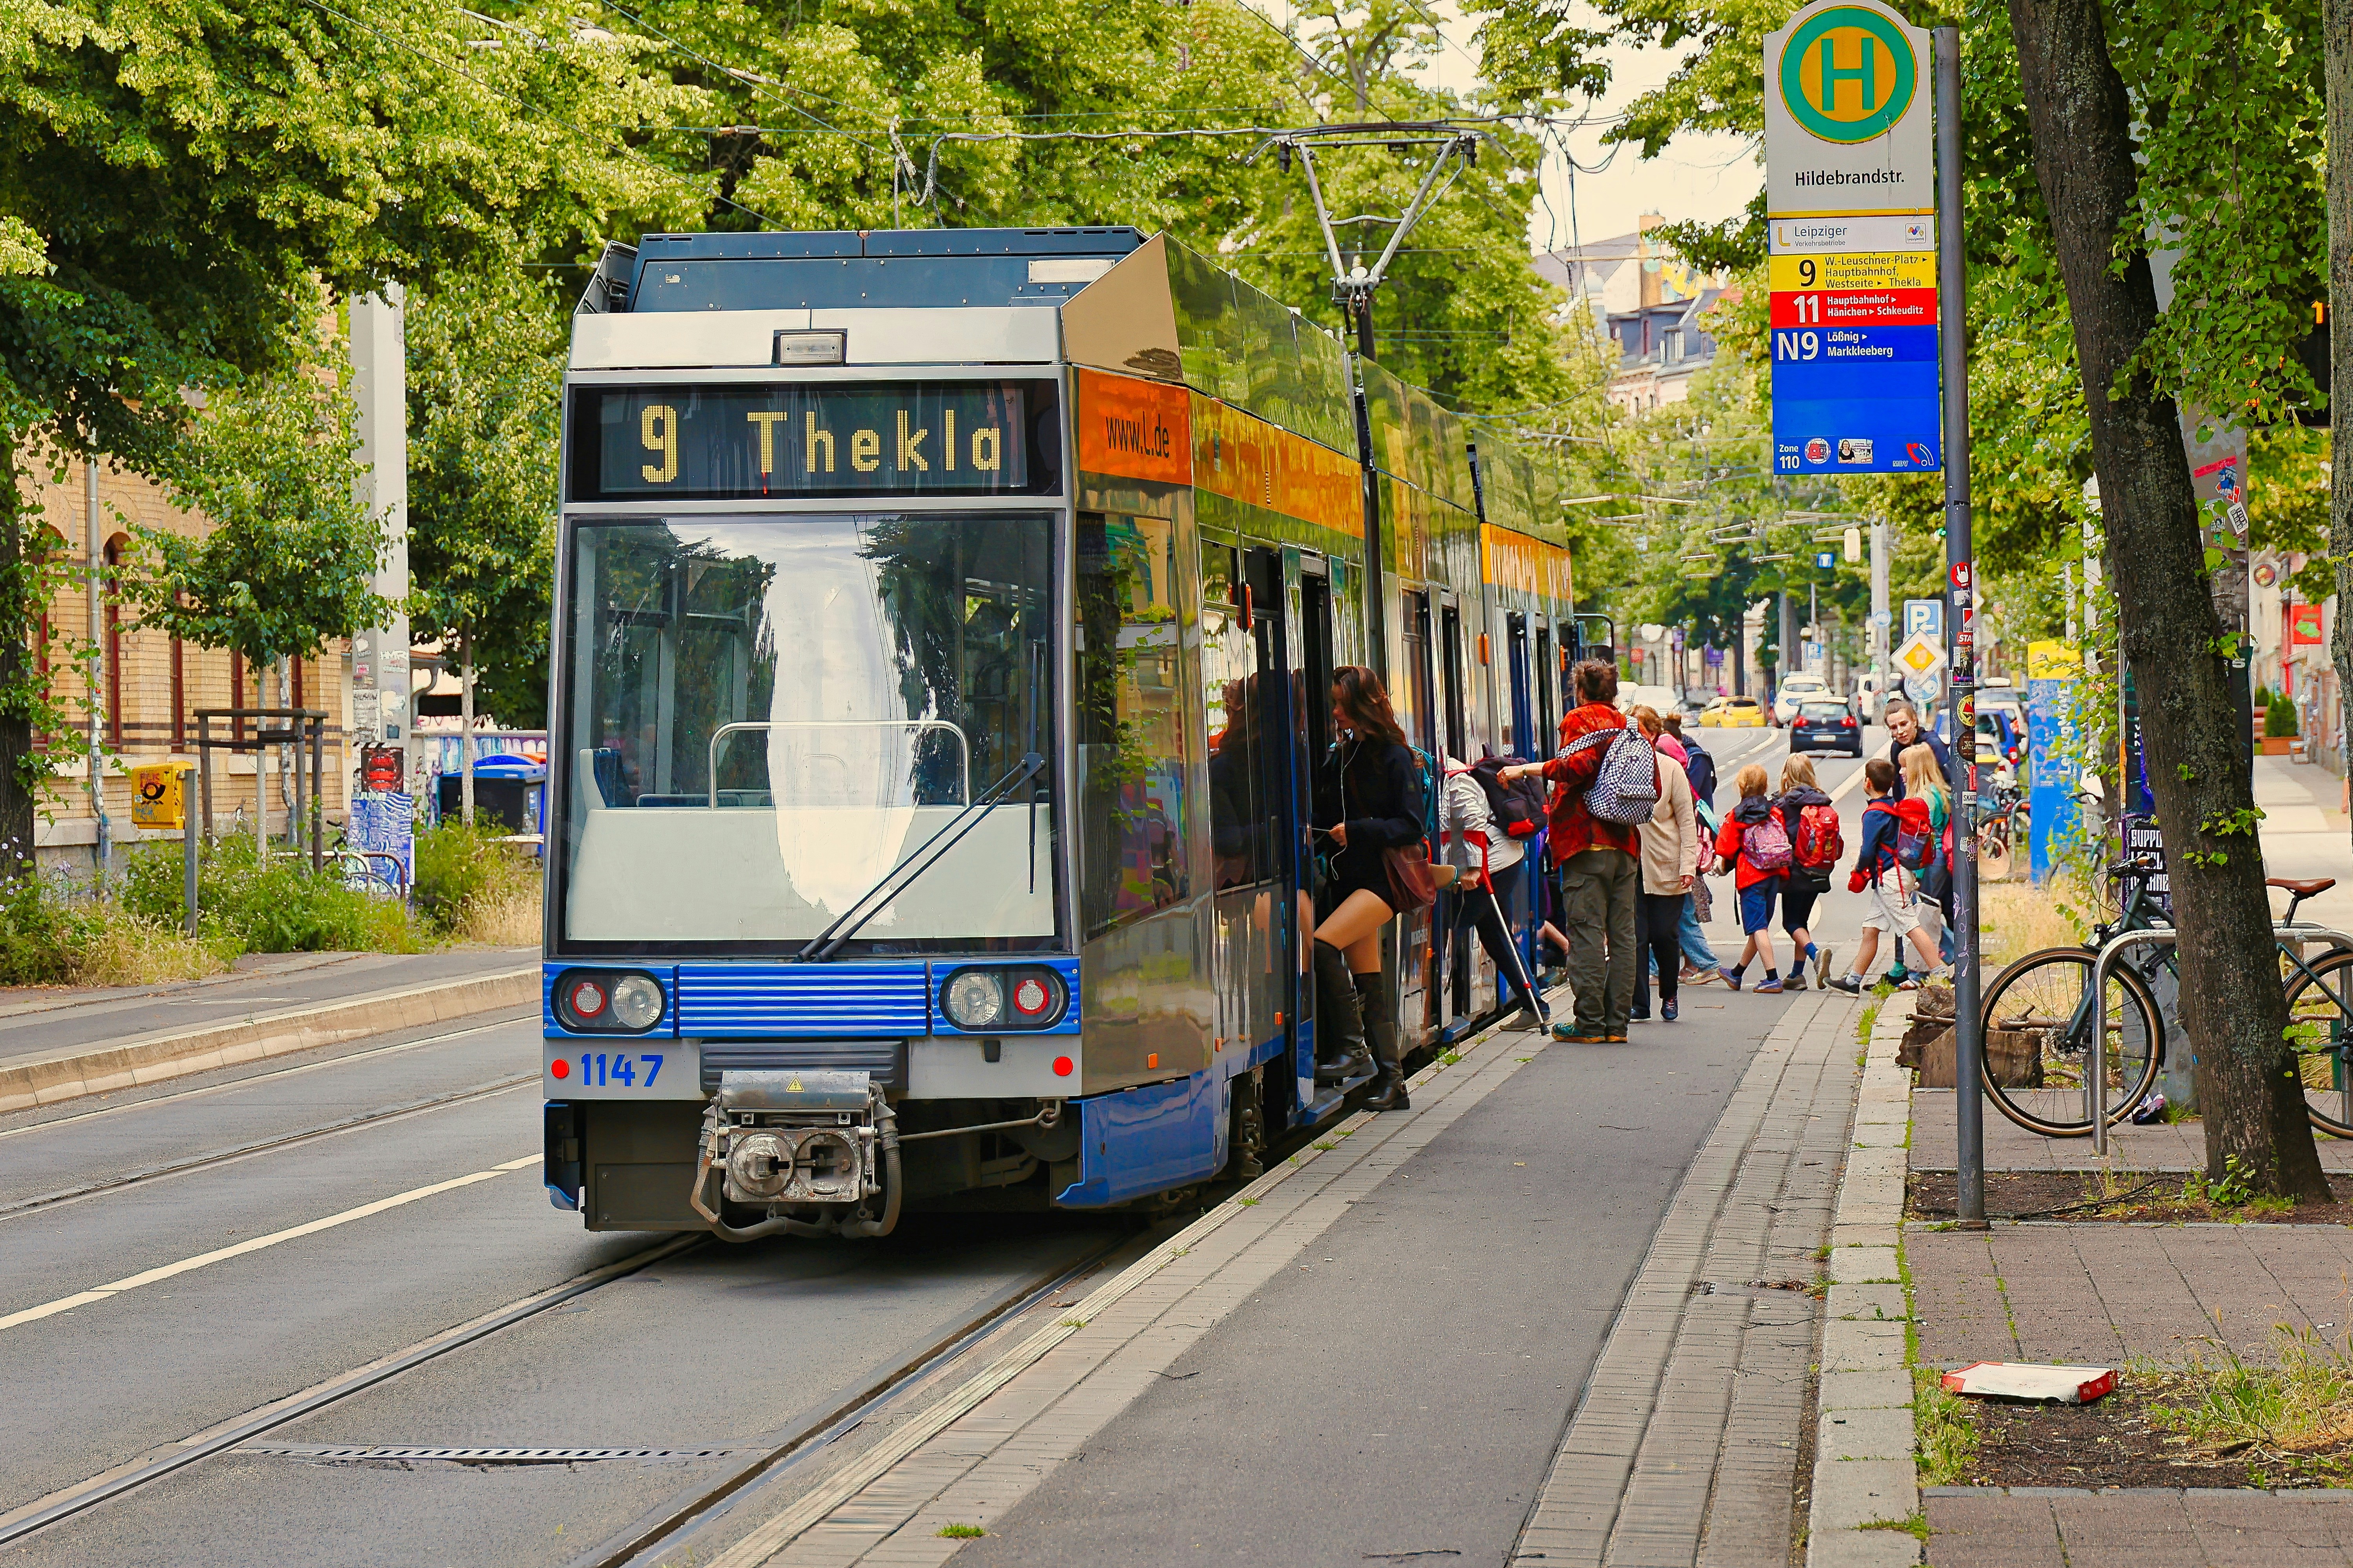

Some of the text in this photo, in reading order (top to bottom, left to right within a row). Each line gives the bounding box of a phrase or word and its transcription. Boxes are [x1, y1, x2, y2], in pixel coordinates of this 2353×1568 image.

[1821, 37, 1875, 111] H
[1795, 169, 1905, 187] Hildebrandstr.
[1795, 226, 1847, 239] Leipziger
[1825, 255, 1918, 266] W.-Leuschner-Platz
[1799, 259, 1817, 287] 9
[1826, 266, 1899, 279] Hauptbahnhof,
[1826, 277, 1921, 289] Westseite Thekla
[1827, 294, 1889, 307] Hauptbahnhof
[1793, 295, 1819, 323] 11
[1827, 305, 1924, 317] Hänichen Schkeuditz
[1827, 331, 1859, 344] Lößnig
[1778, 332, 1819, 361] N9
[1827, 345, 1893, 358] Markkleeberg
[641, 404, 1001, 483] 9 Thekla
[1779, 444, 1799, 453] Zone
[1779, 455, 1800, 469] 110
[1910, 605, 1931, 634] P
[1958, 634, 1973, 643] STA
[581, 1053, 664, 1087] 1147
